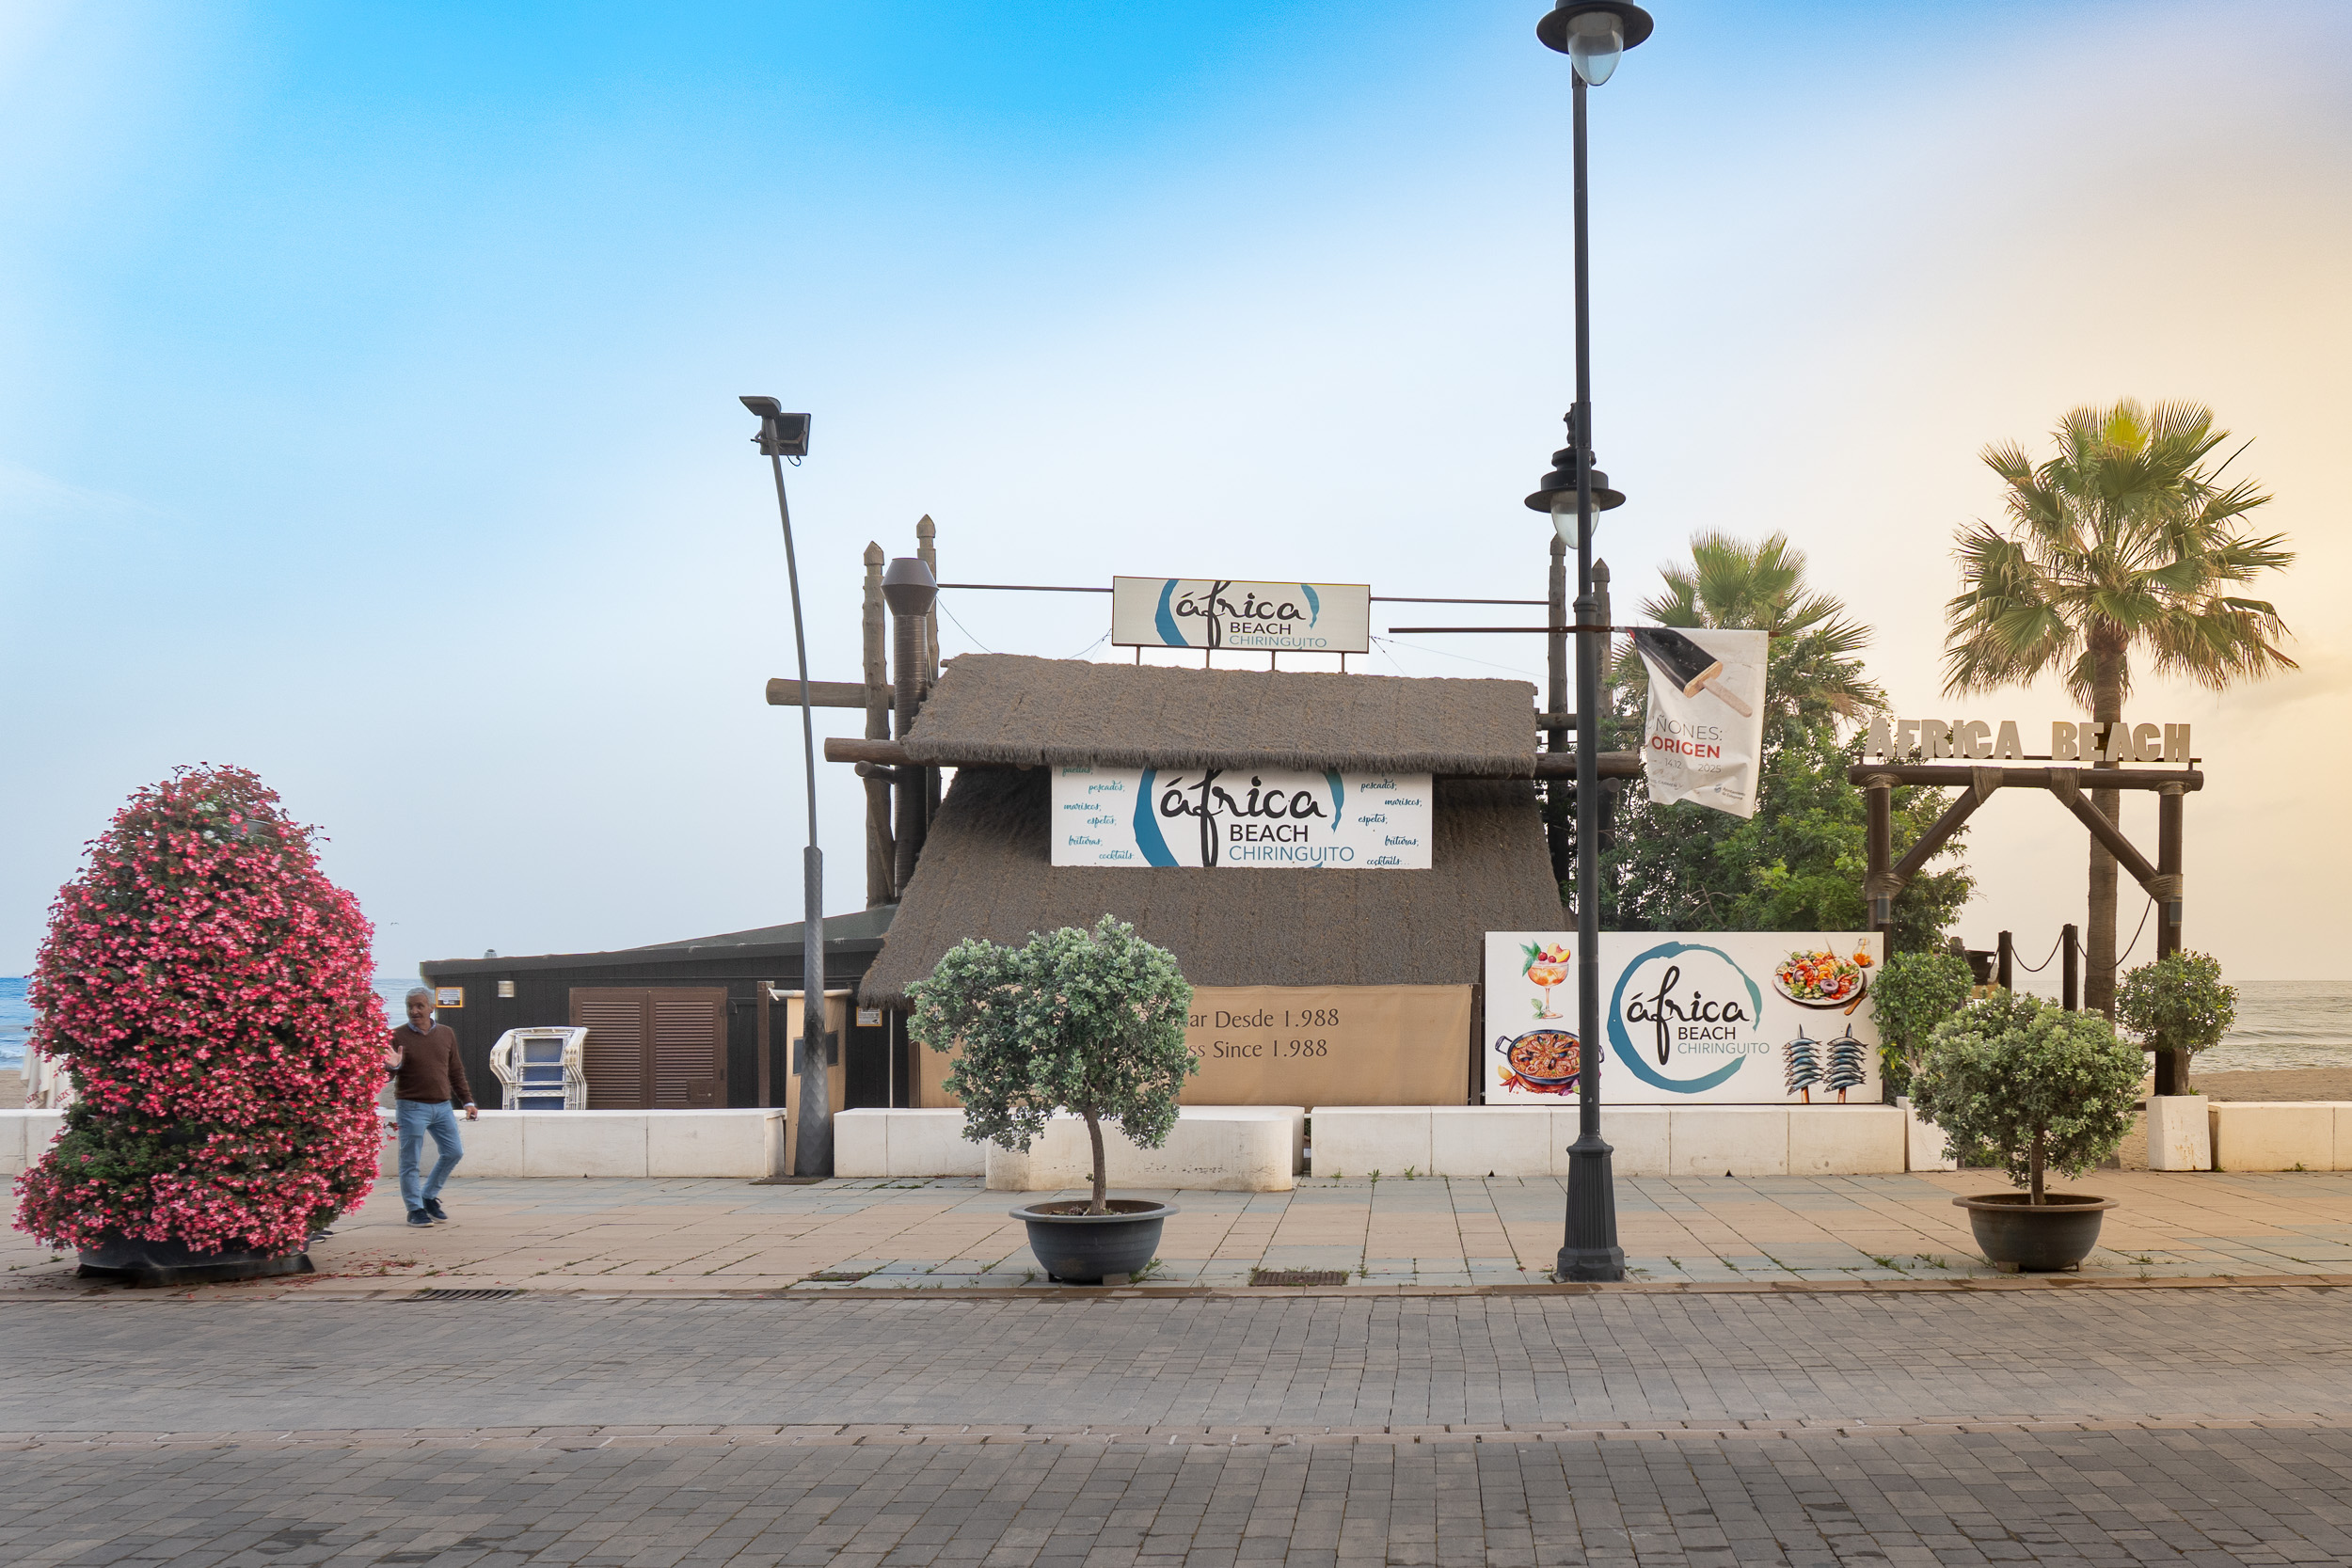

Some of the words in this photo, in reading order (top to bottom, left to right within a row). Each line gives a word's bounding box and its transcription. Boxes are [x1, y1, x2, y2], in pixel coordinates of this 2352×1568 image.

[1176, 580, 1306, 648] áfrica
[1230, 622, 1292, 636] BEACH
[1229, 635, 1327, 648] CHIRINGUITO
[1648, 715, 1723, 741] ÑONES:
[1651, 736, 1721, 759] ORIGEN
[1864, 717, 2024, 760] AFRICA
[2052, 721, 2191, 763] BEACH
[1697, 763, 1722, 773] 2025
[1160, 769, 1327, 867] áfrica
[1230, 824, 1309, 843] BEACH
[1229, 845, 1355, 862] CHIRINGUITO
[1216, 1009, 1275, 1028] Desde
[1285, 1008, 1340, 1028] 1.988
[1627, 965, 1751, 1066] áfrica
[1677, 1026, 1736, 1040] BEACH
[1213, 1040, 1263, 1058] Since
[1273, 1039, 1328, 1058] 1.988
[1677, 1042, 1771, 1054] CHIRINGUITO
